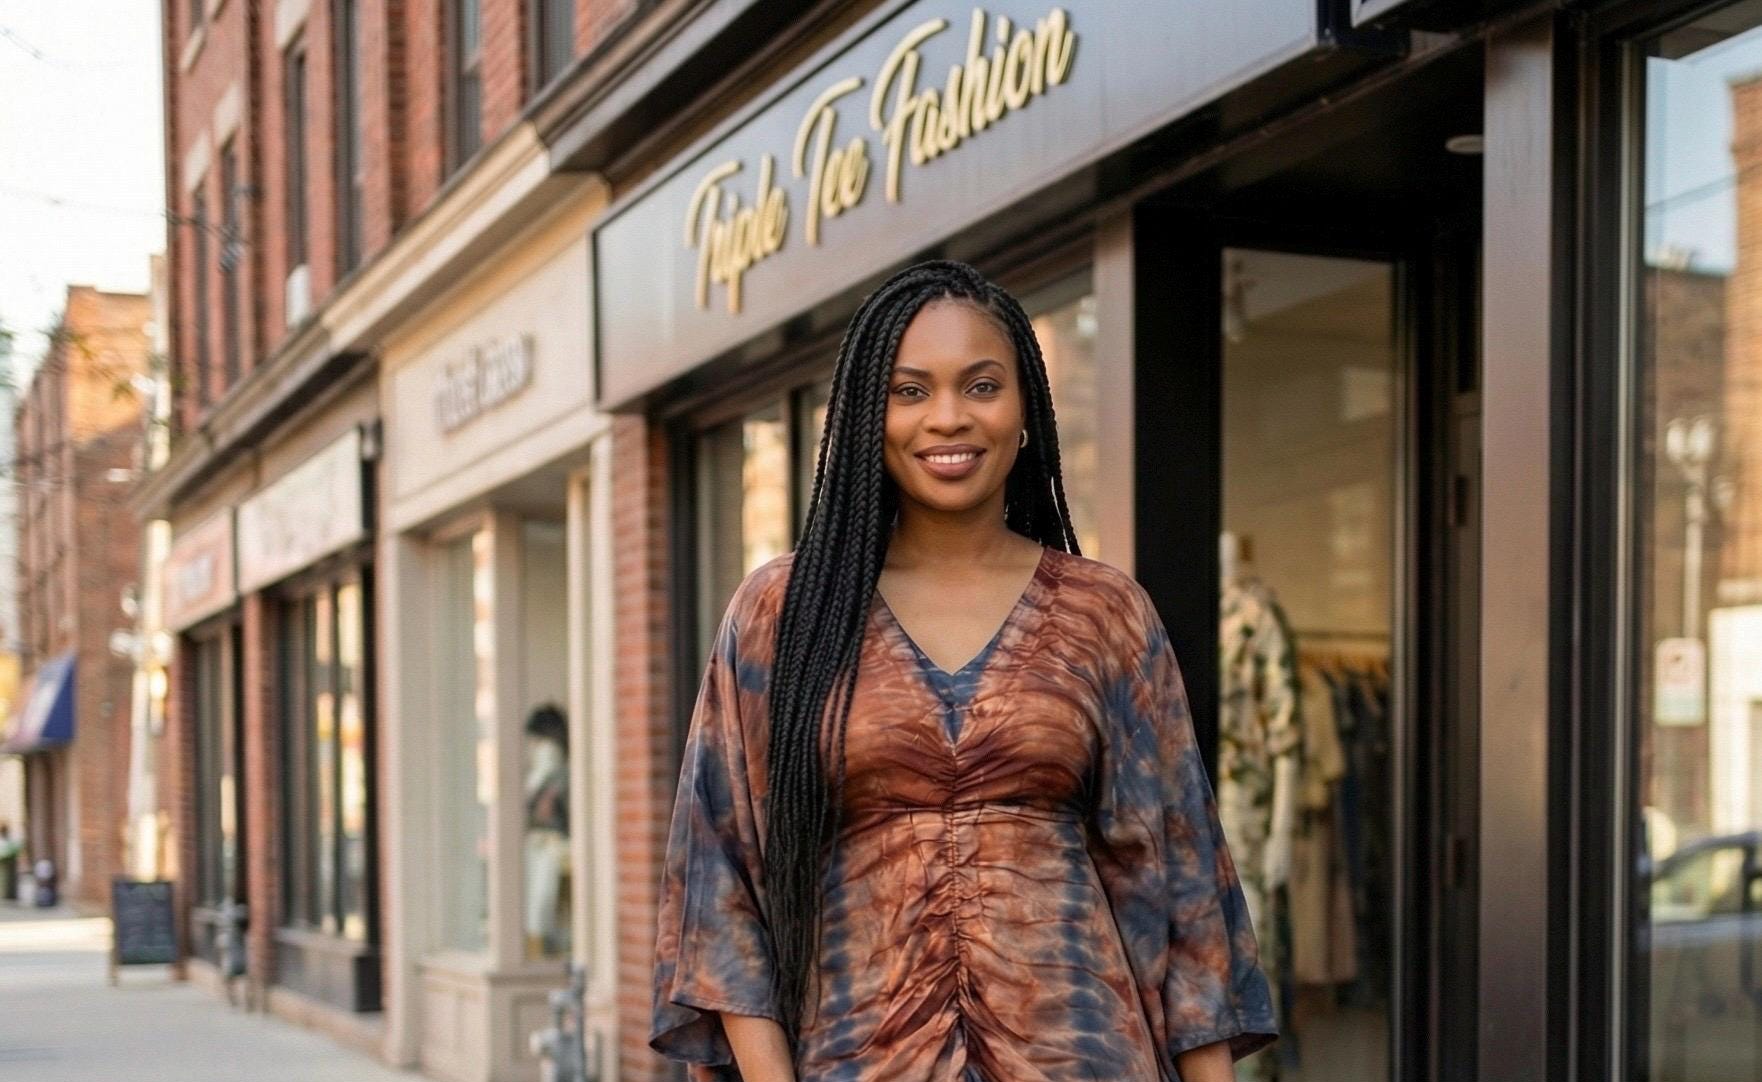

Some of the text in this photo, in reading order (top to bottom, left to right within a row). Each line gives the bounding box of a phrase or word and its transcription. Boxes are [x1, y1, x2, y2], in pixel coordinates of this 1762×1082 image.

[685, 7, 1075, 313] Triple Tee Fashion
